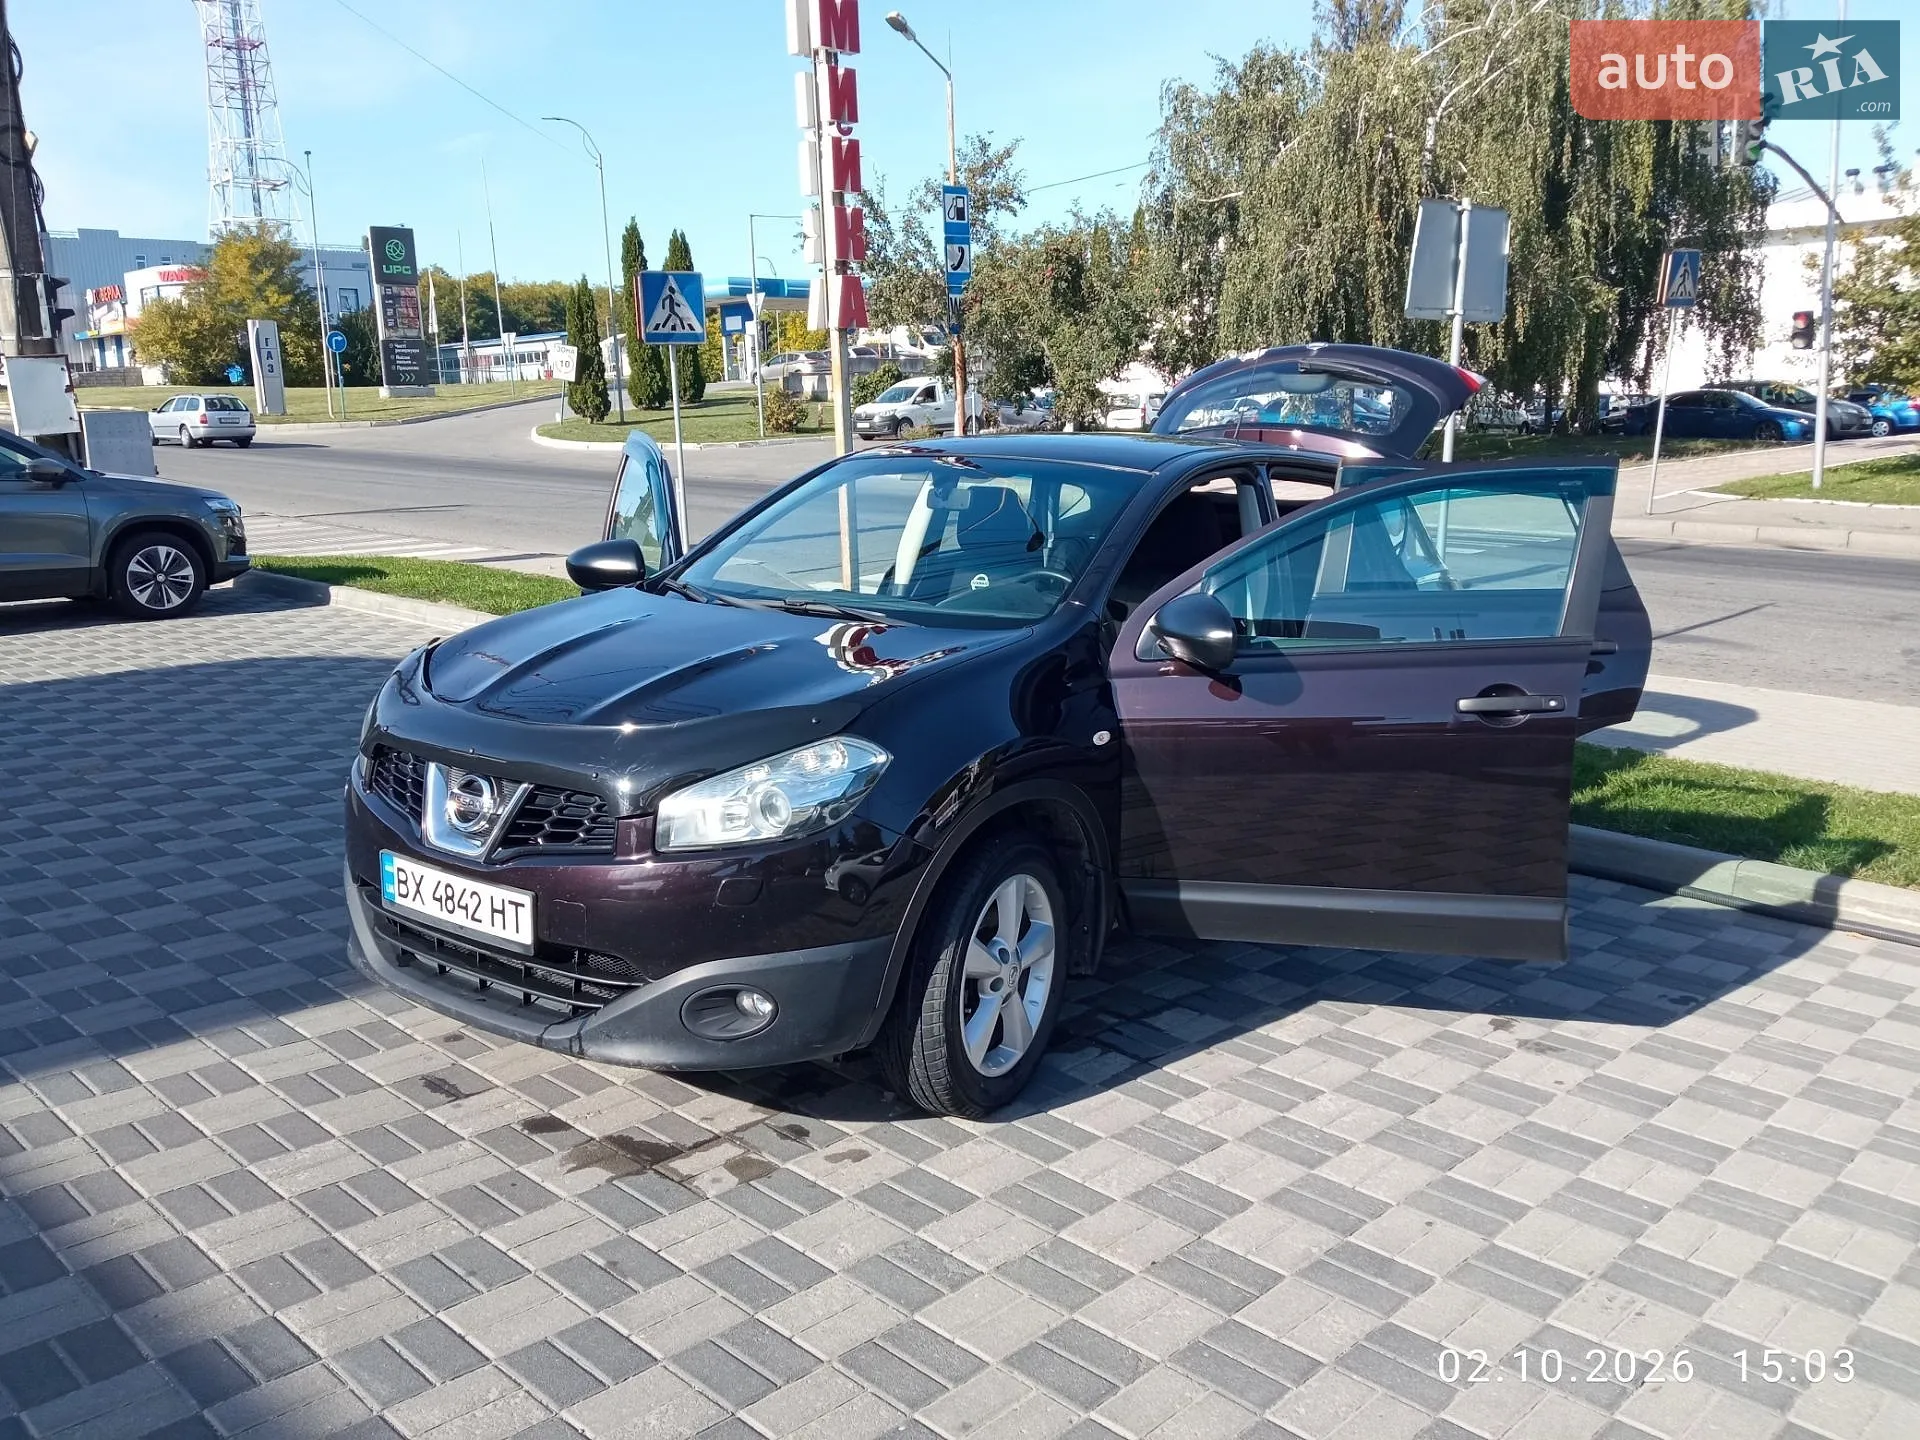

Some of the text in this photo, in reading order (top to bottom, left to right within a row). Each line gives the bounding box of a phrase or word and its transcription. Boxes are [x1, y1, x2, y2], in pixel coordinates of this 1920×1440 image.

[820, 0, 869, 329] МИЙКА
[383, 264, 412, 274] UPG
[265, 338, 275, 373] ГАЗ
[560, 360, 571, 369] 10
[397, 867, 525, 934] BX 4842 HT
